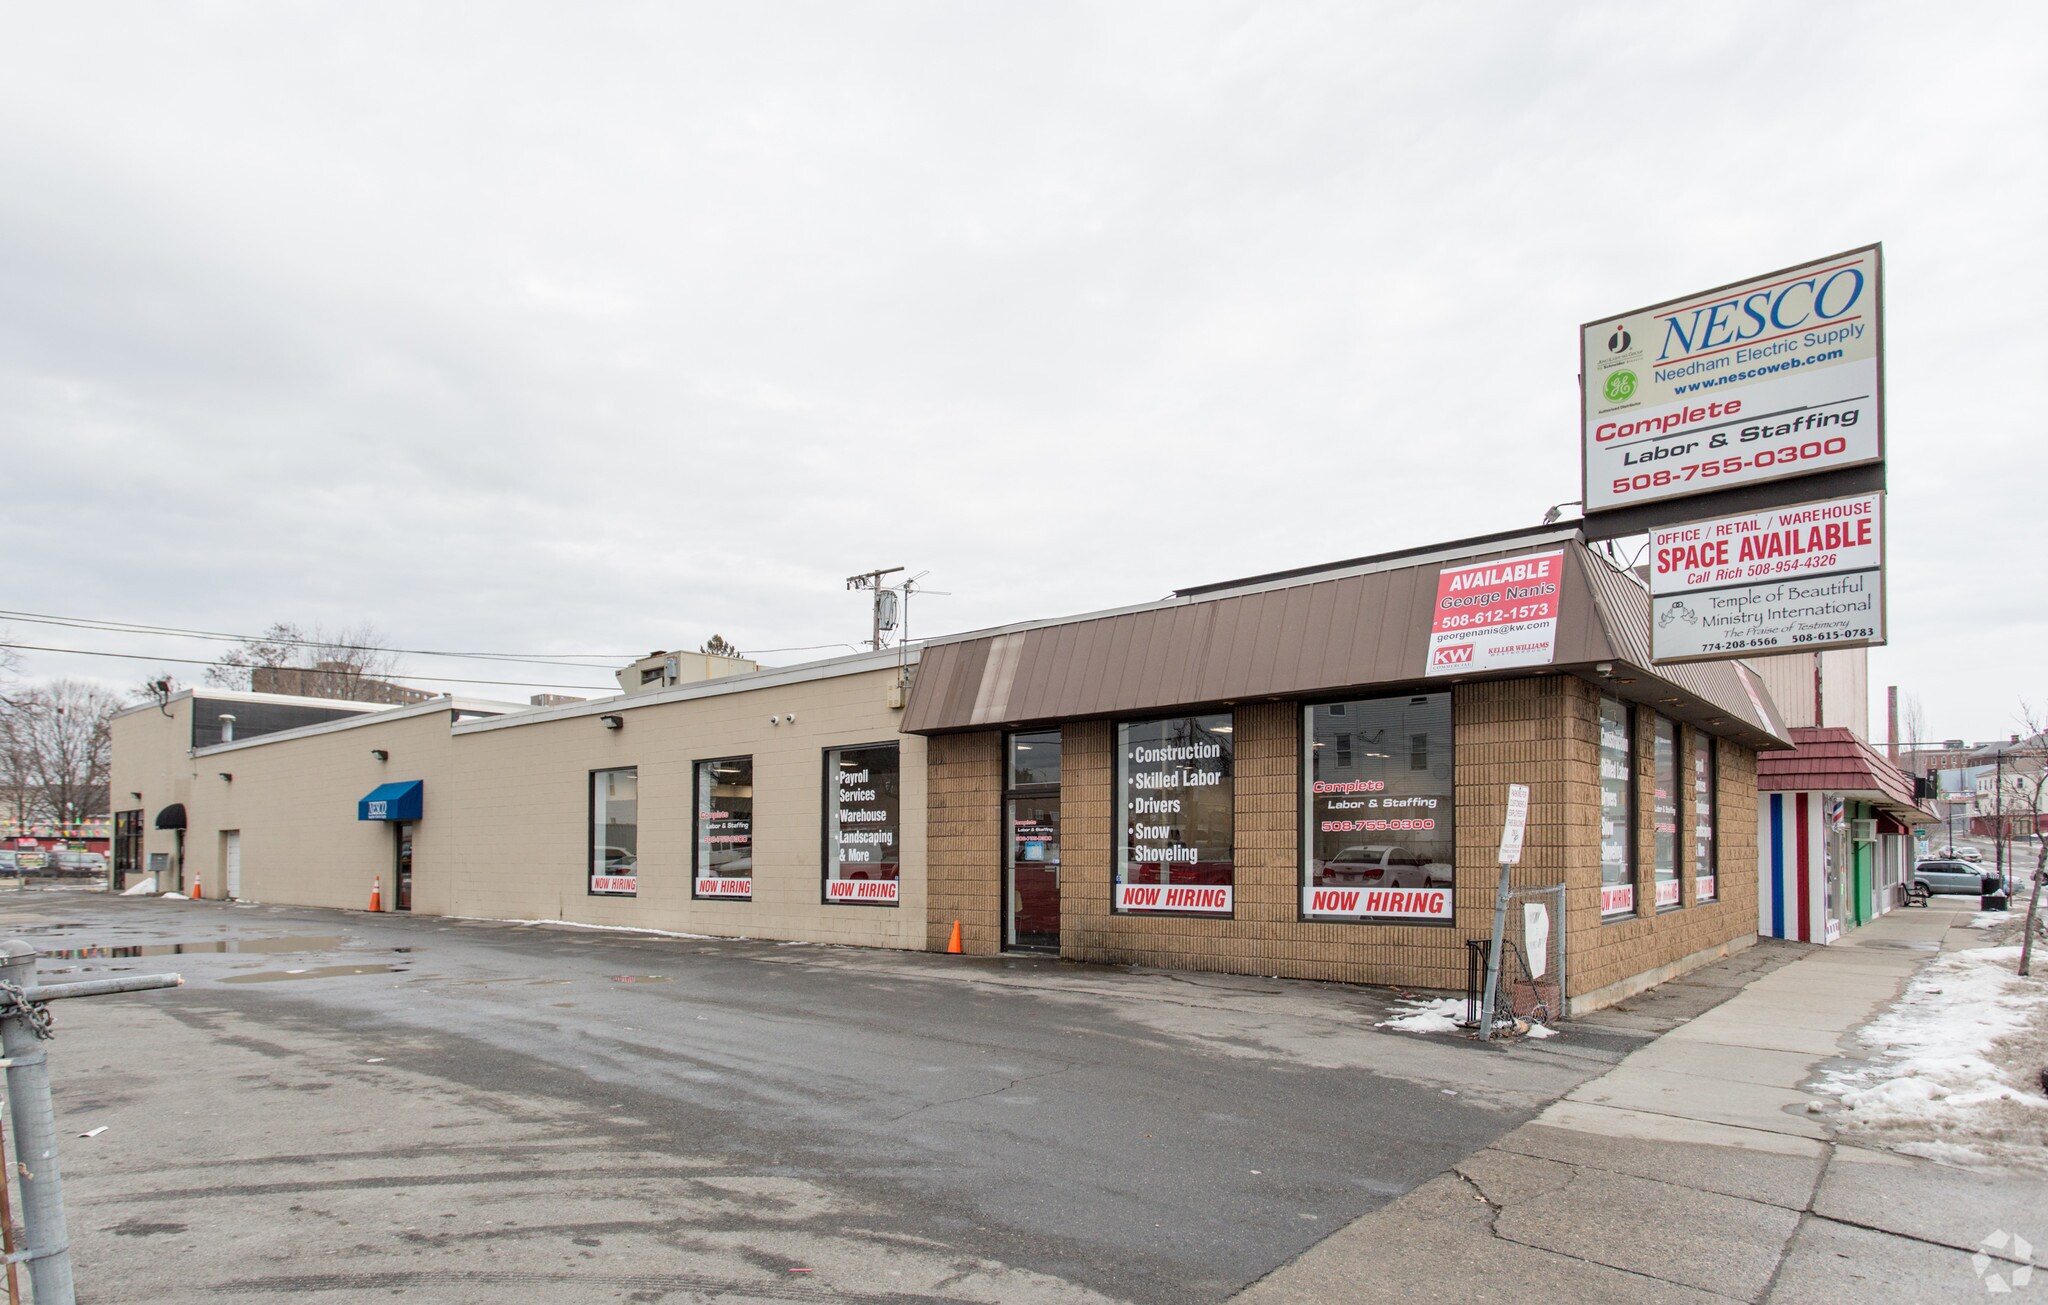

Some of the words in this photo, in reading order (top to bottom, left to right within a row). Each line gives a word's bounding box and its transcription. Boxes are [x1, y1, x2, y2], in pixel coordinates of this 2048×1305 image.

[1656, 268, 1864, 361] NESCO
[1655, 351, 1730, 383] Needham
[1736, 340, 1798, 363] Electric
[1804, 322, 1865, 347] Supply
[1674, 348, 1843, 395] www.nescoweb.com
[1595, 400, 1742, 443] Complete
[1623, 441, 1699, 466] Labor
[1709, 433, 1728, 449] &
[1740, 409, 1860, 444] Staffing
[1612, 437, 1846, 494] 508-755-0300
[1657, 528, 1701, 546] OFFICE
[1706, 527, 1711, 539] /
[1716, 519, 1762, 536] RETAIL
[1767, 517, 1773, 530] /
[1779, 501, 1872, 527] WAREHOUSE
[1657, 540, 1729, 574] SPACE
[1739, 518, 1872, 563] AVAILABLE
[1449, 560, 1550, 592] AVAILABLE
[1687, 571, 1711, 585] Call
[1715, 567, 1742, 581] Rich
[1747, 554, 1837, 577] 508-954-4326
[1440, 591, 1500, 610] George
[1506, 583, 1555, 600] Nanis
[1709, 589, 1762, 612] Temple
[1765, 585, 1784, 603] of
[1788, 576, 1863, 600] Beautiful
[1441, 603, 1549, 629] 508-612-1573
[1702, 610, 1763, 629] Ministry
[1768, 594, 1872, 619] International
[1437, 620, 1550, 643] georgenanis@kw.com
[1724, 629, 1743, 639] The
[1781, 622, 1794, 634] of
[1796, 618, 1849, 632] Testimony
[1488, 646, 1514, 655] KELLER
[1515, 642, 1549, 651] WILLIAMS
[1702, 637, 1778, 652] 774-208-6566
[1792, 628, 1874, 644] 508-615-0783
[1433, 648, 1473, 665] KW
[1135, 742, 1220, 763] Construction
[840, 769, 869, 787] Payroll
[1135, 771, 1179, 790] Skilled
[1182, 769, 1221, 787] Labor
[1313, 780, 1384, 794] Complete
[840, 788, 876, 803] Services
[1135, 797, 1181, 814] Drivers
[1328, 800, 1364, 810] Labor
[1369, 799, 1379, 808] &
[1383, 797, 1437, 809] Staffing
[727, 822, 749, 830] Staffing
[840, 809, 887, 823] Warehouse
[1321, 819, 1435, 832] 508-755-0300
[839, 829, 893, 846] Landscaping
[1135, 822, 1171, 840] Snow
[839, 848, 846, 862] &
[848, 848, 870, 862] More
[1135, 844, 1198, 865] Shoveling
[594, 877, 610, 889] NOW
[611, 878, 636, 890] HIRING
[699, 880, 718, 893] NOW
[720, 881, 750, 894] HIRING
[830, 882, 855, 897] NOW
[857, 882, 897, 898] HIRING
[1123, 887, 1161, 905] NOW
[1165, 889, 1227, 908] HIRING
[1312, 891, 1360, 911] NOW
[1366, 891, 1445, 913] HIRING
[1602, 891, 1612, 911] OW
[1612, 888, 1631, 910] HIRING
